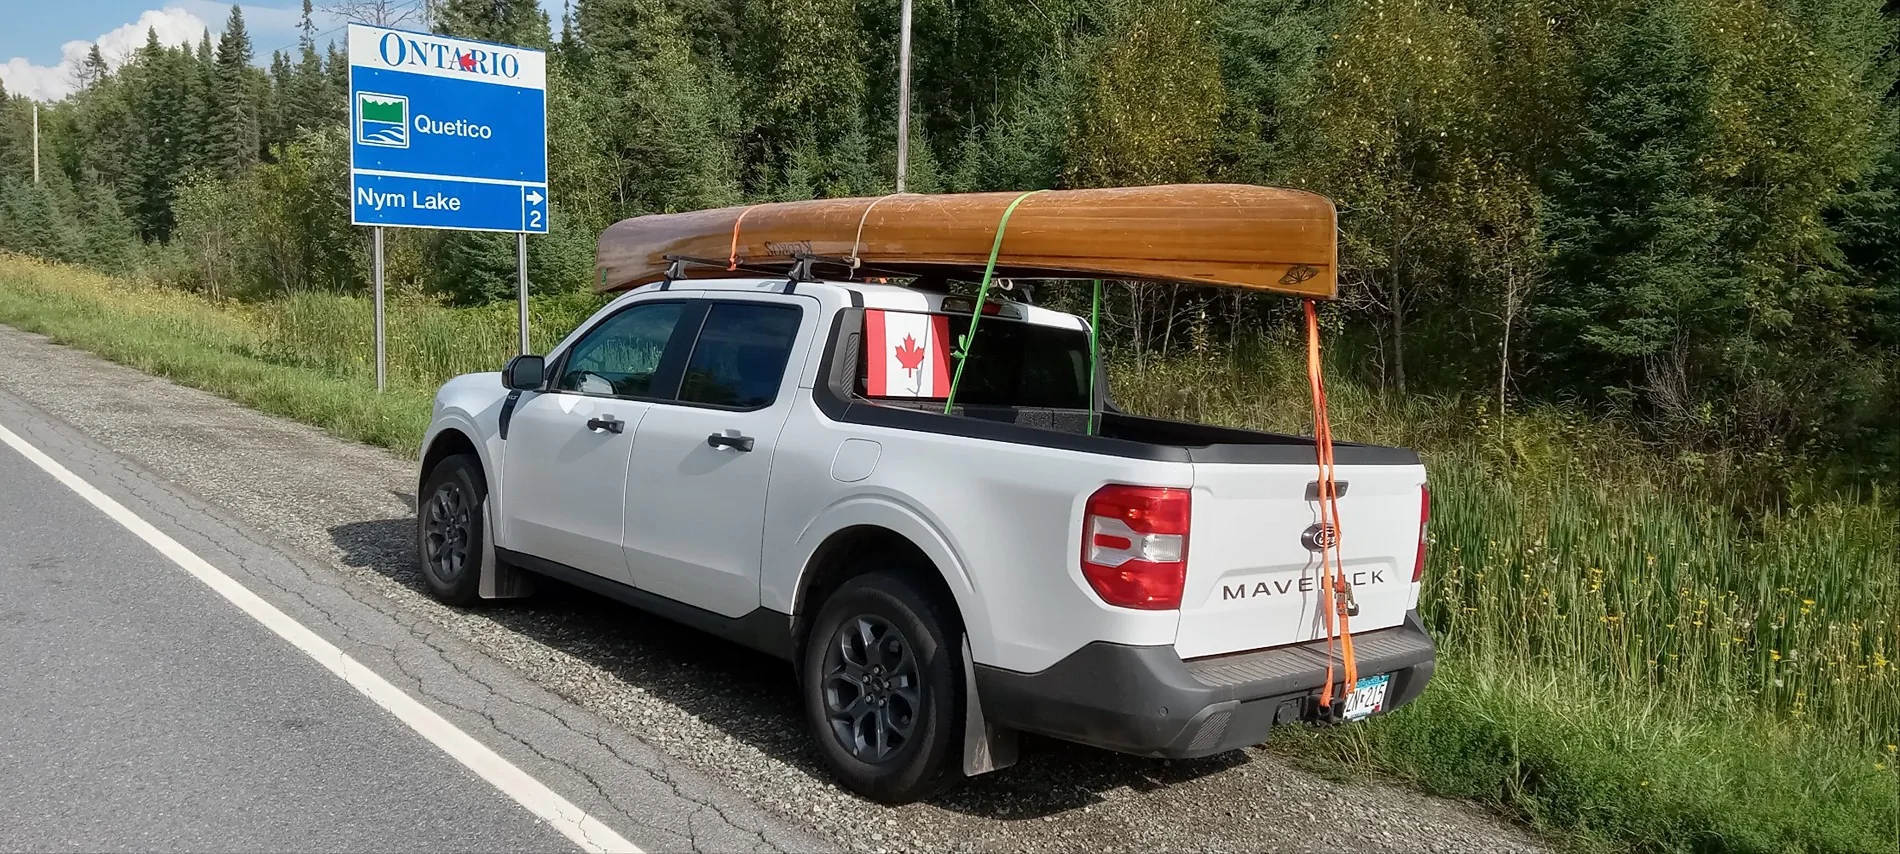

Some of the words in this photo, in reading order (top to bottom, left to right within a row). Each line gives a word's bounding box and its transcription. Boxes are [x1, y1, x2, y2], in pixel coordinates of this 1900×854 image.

[379, 32, 519, 78] ONTARIO
[414, 114, 492, 139] Quetico
[357, 187, 405, 211] Nym
[412, 190, 461, 211] Lake
[529, 210, 542, 228] 2
